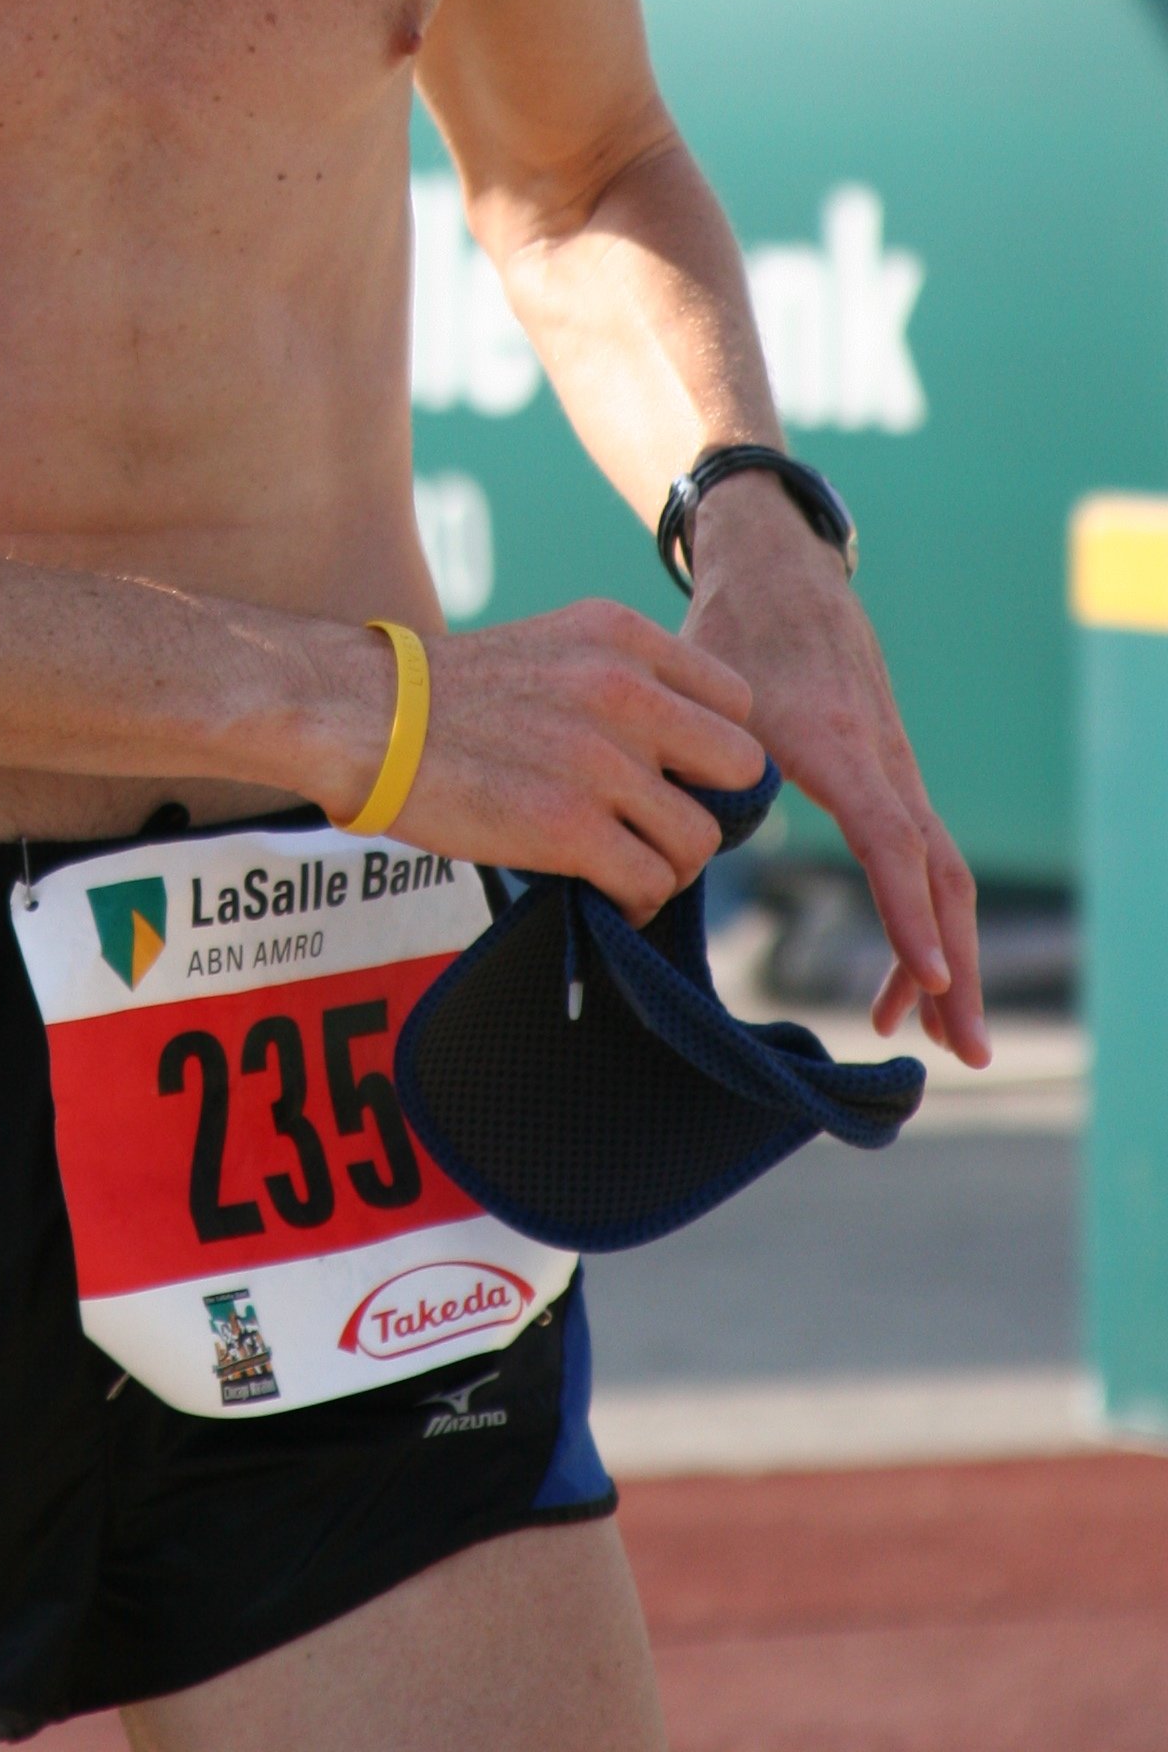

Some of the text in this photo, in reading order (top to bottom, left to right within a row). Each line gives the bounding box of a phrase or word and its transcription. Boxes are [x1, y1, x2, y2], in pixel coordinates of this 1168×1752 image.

[191, 850, 456, 928] LaSalle Bank
[186, 931, 324, 979] ABN AMRO
[157, 998, 423, 1245] 235
[371, 1282, 512, 1344] Takeda
[423, 1409, 507, 1439] MIZUNO
